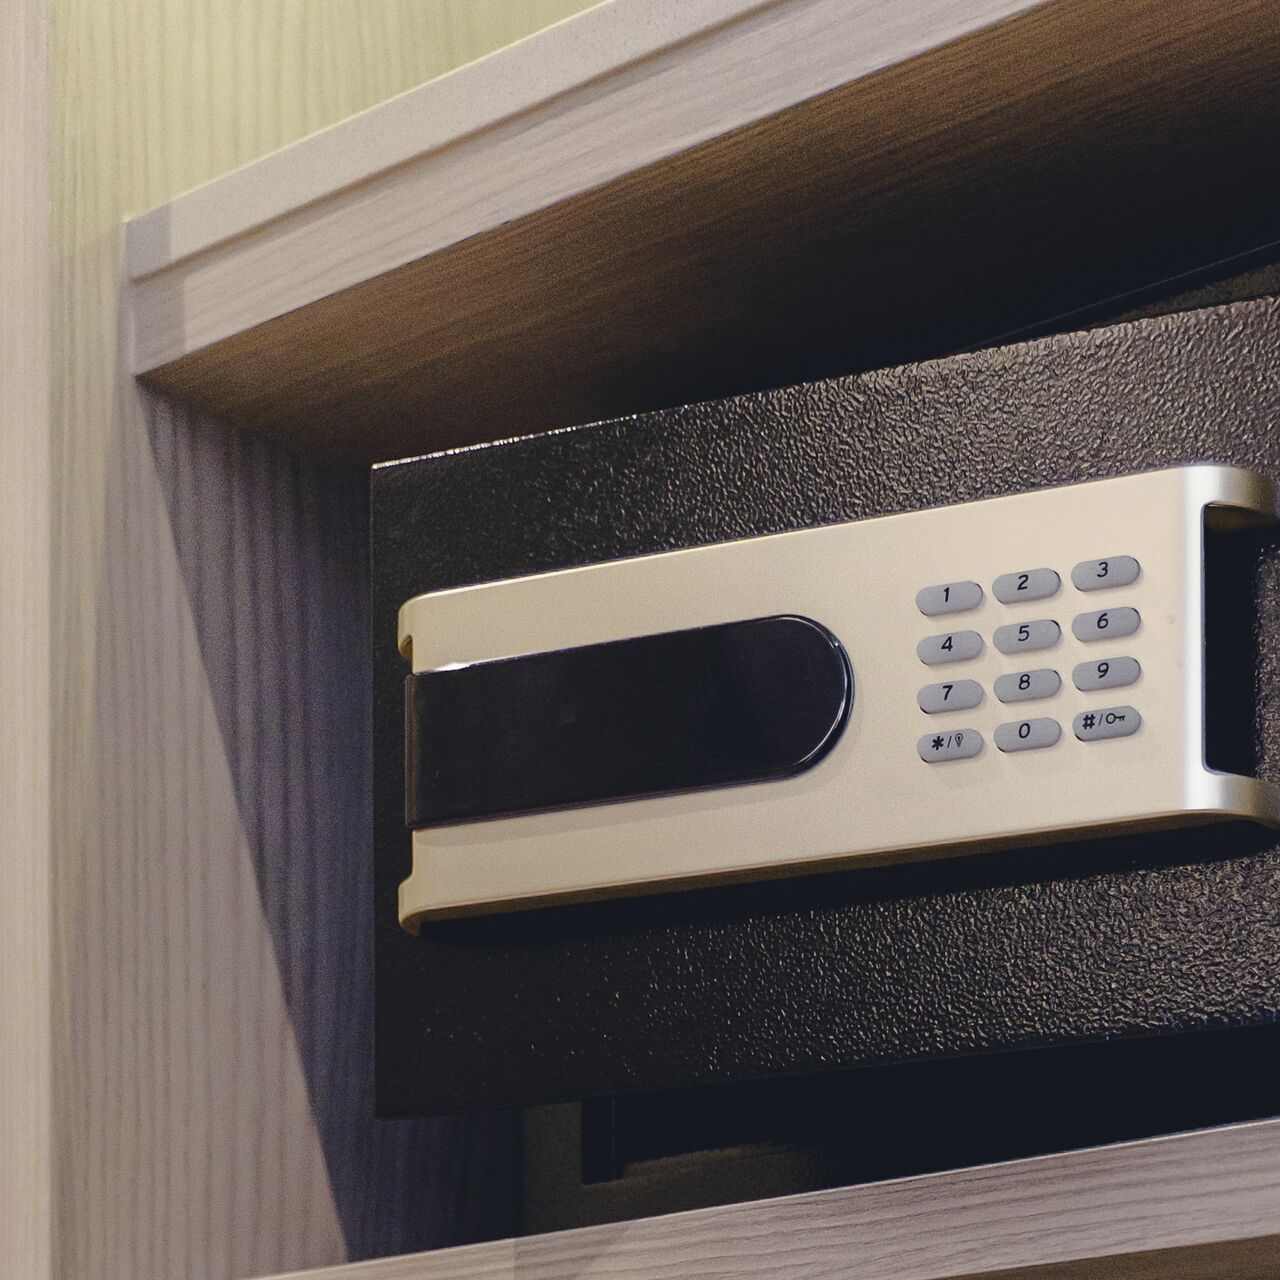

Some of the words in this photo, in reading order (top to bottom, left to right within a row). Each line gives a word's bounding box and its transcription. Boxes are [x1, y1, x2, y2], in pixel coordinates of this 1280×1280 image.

[1097, 561, 1108, 578] 3
[1017, 574, 1029, 590] 2
[943, 587, 950, 602] 1
[1096, 613, 1109, 629] 6
[1017, 625, 1029, 641] 5
[941, 636, 953, 651] 4
[1097, 662, 1109, 679] 9
[1018, 674, 1030, 690] 8
[942, 685, 953, 700] 7
[1018, 723, 1030, 739] 0
